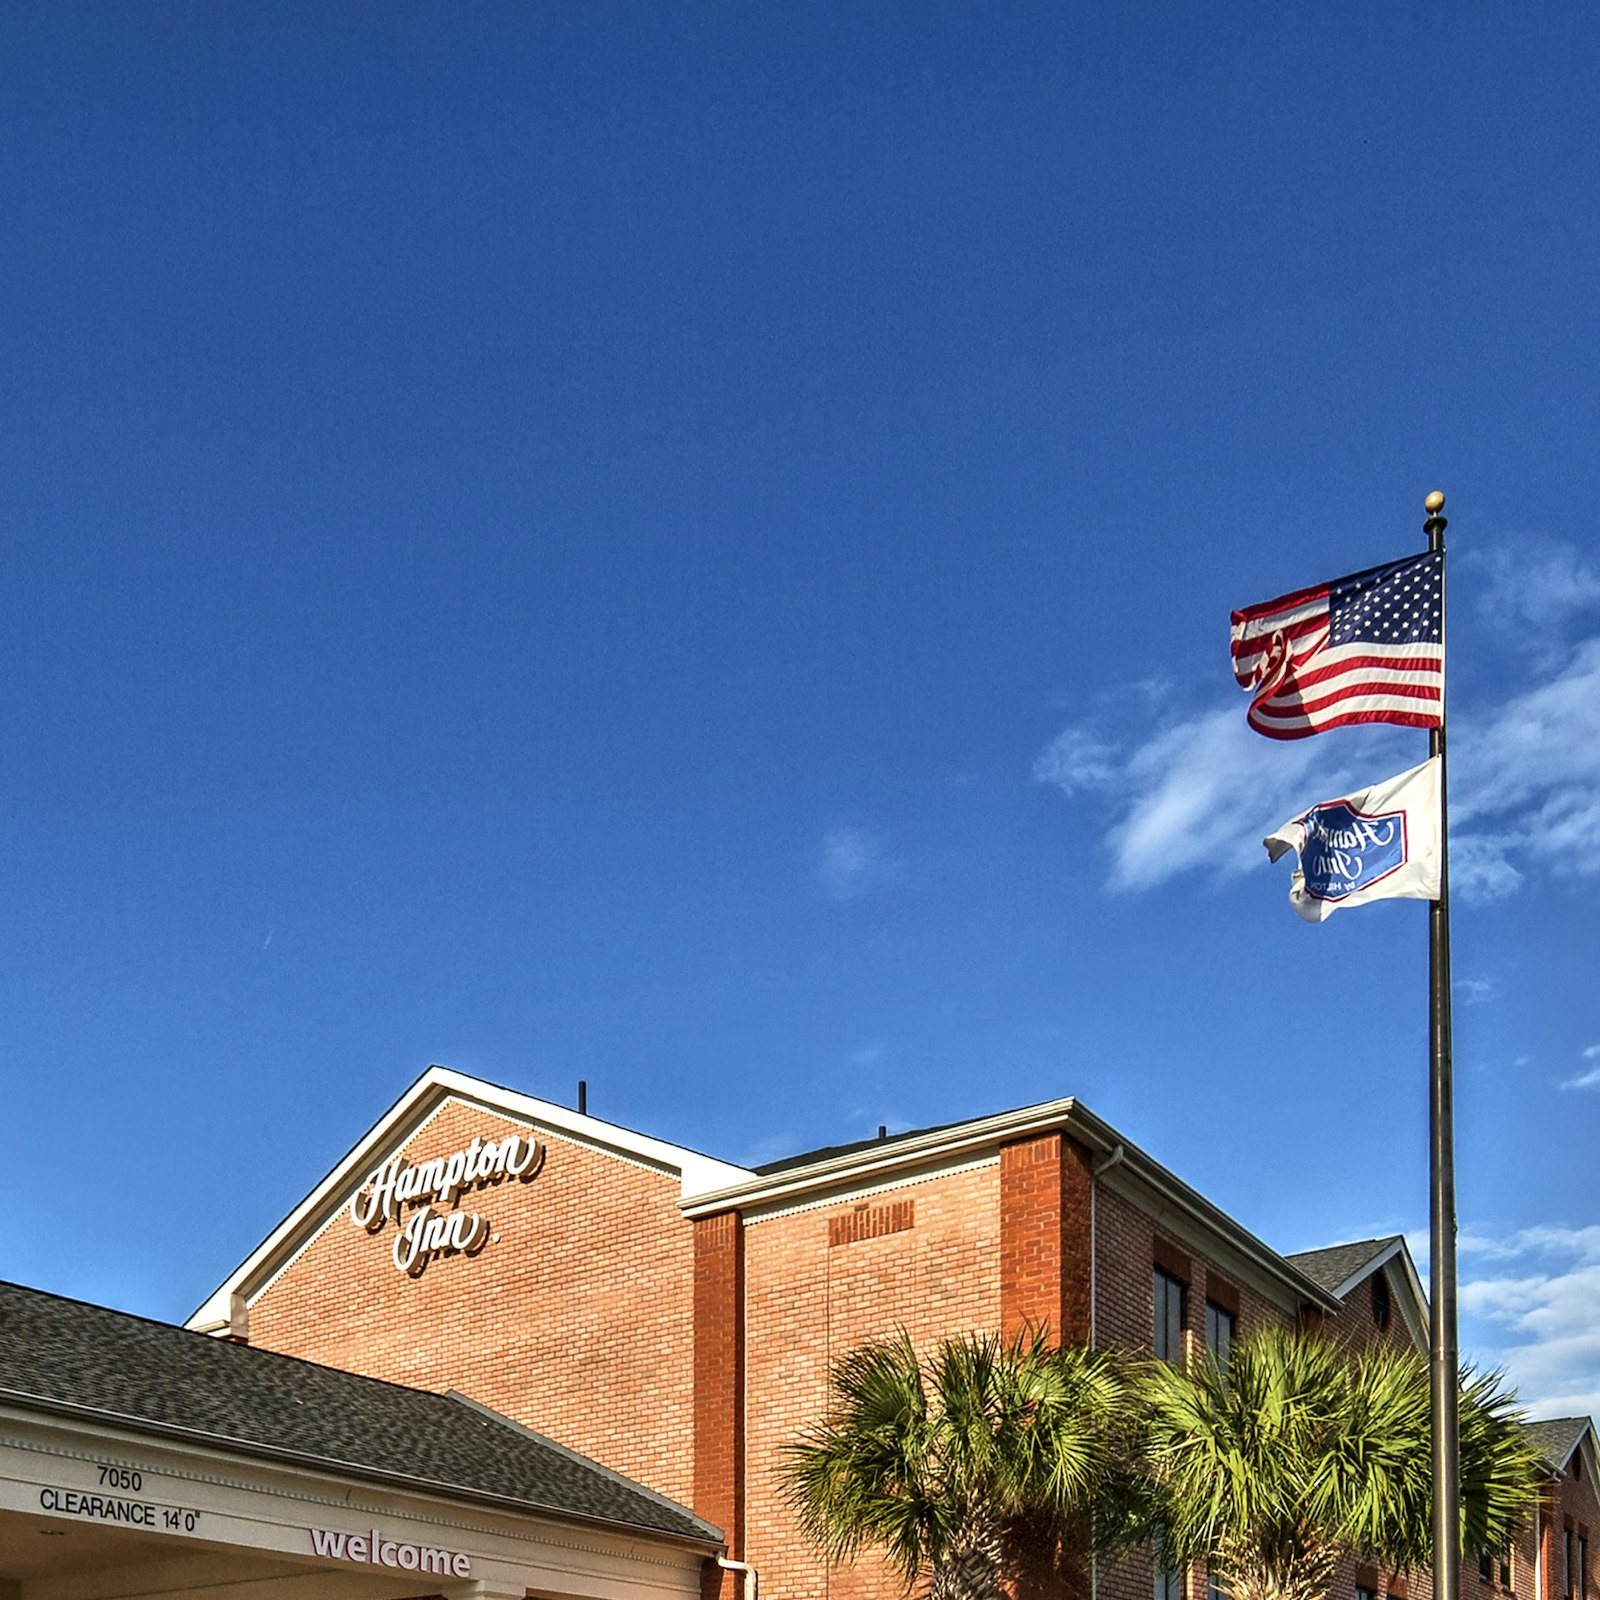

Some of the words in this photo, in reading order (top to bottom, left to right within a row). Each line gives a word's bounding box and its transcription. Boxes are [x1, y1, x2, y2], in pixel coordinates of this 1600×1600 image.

[350, 1135, 539, 1227] Hampton
[393, 1205, 483, 1271] Inn
[97, 1465, 143, 1492] 7050
[39, 1488, 156, 1526] CLEARANCE
[309, 1528, 472, 1579] welcome
